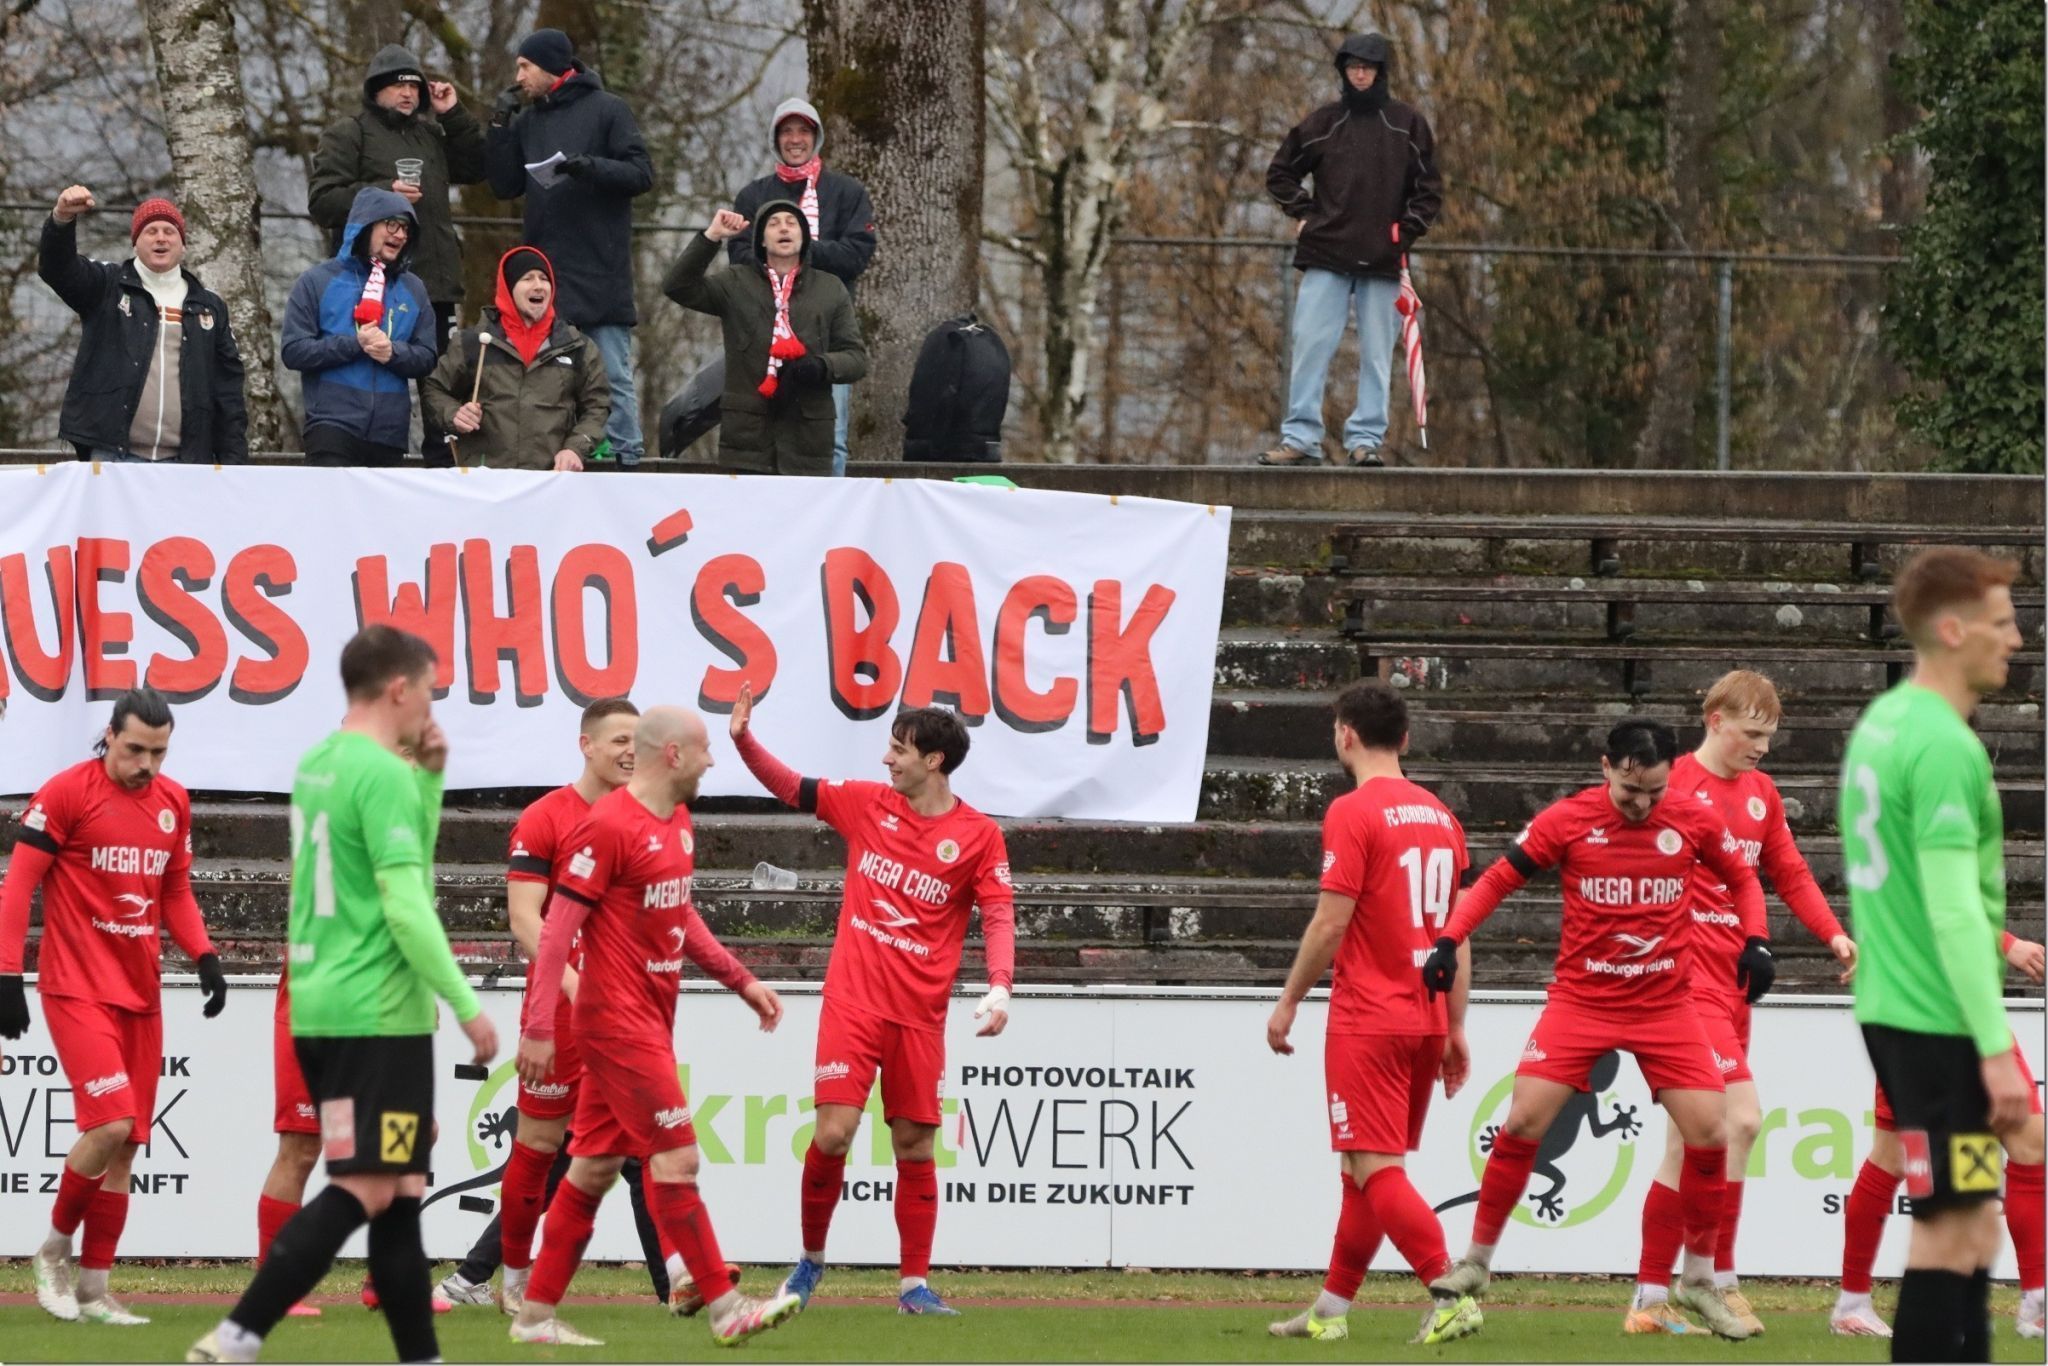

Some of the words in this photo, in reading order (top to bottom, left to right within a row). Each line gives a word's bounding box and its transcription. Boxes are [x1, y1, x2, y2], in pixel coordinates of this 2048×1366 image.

[0, 536, 309, 706] UESS
[821, 547, 1177, 748] BACK
[92, 846, 140, 874] MEGA
[858, 850, 897, 889] MEGA
[902, 869, 951, 905] CARS
[1399, 847, 1454, 928] 14
[1580, 876, 1632, 904] MEGA
[1639, 876, 1684, 904] CARS
[643, 878, 680, 909] MEGA
[1586, 958, 1644, 977] herburger
[1646, 957, 1675, 973] reisen
[961, 1065, 1195, 1089] PHOTOVOLTAIK
[964, 1098, 1196, 1170] WERK
[946, 1182, 976, 1203] IN
[988, 1183, 1037, 1204] DIE
[1046, 1184, 1195, 1206] ZUKUNFT
